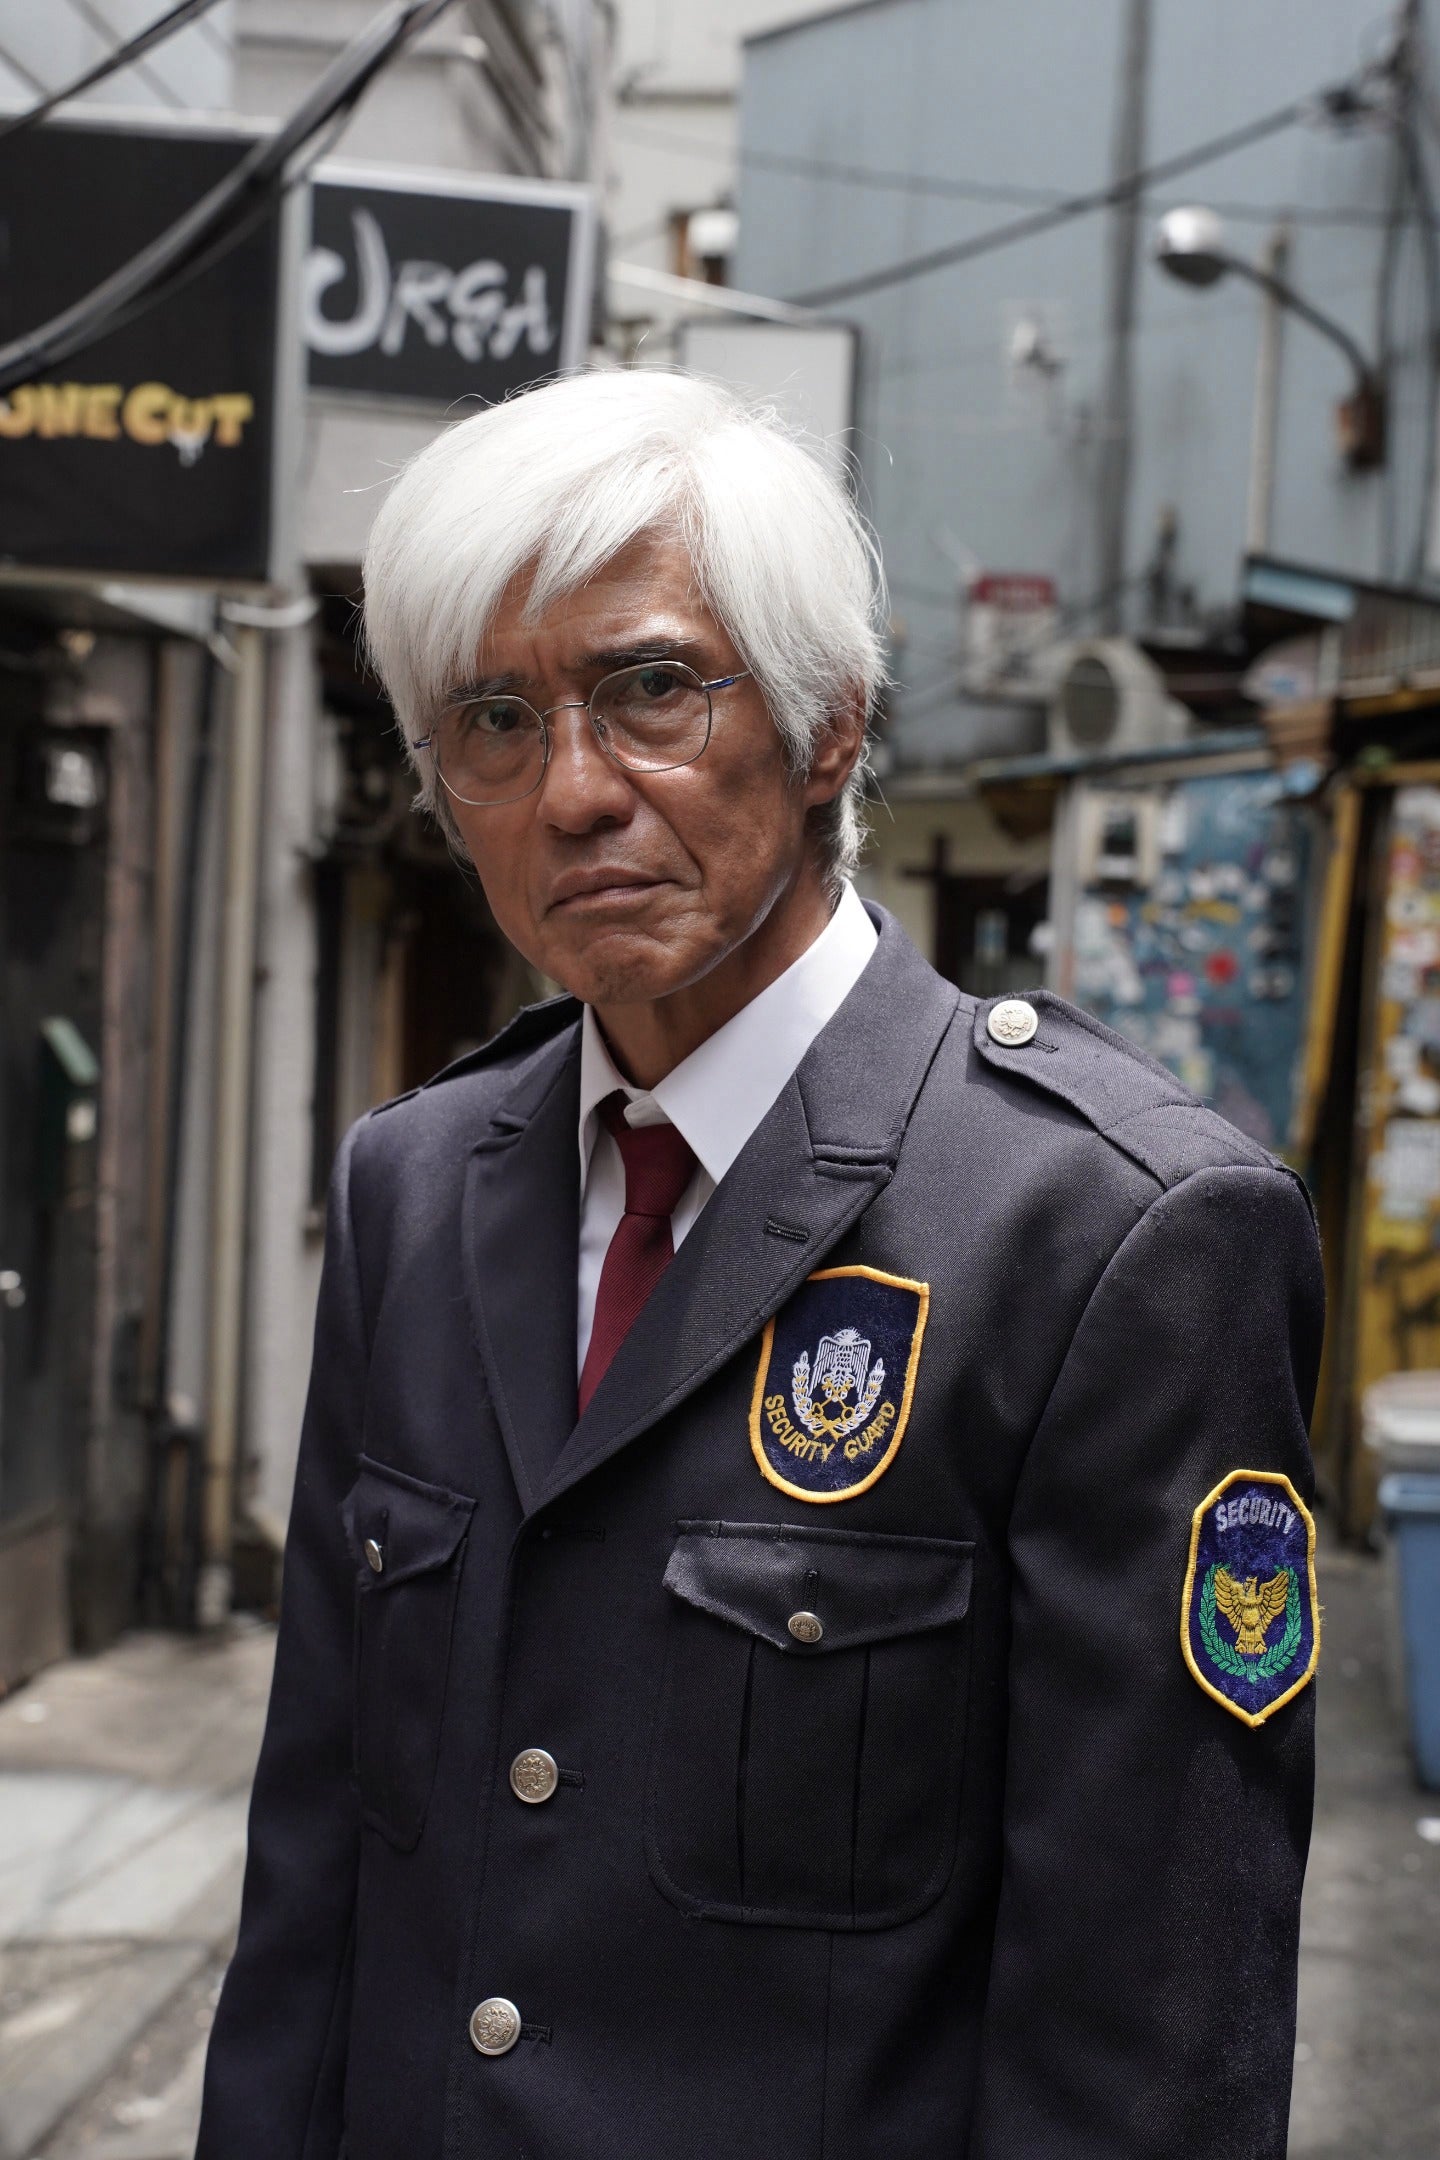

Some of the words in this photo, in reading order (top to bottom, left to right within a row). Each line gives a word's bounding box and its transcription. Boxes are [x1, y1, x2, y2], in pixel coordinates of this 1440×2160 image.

[122, 380, 254, 447] CUT
[764, 1394, 836, 1463] SECURITY
[843, 1401, 896, 1459] GUARD
[1214, 1497, 1297, 1535] SECURITY
